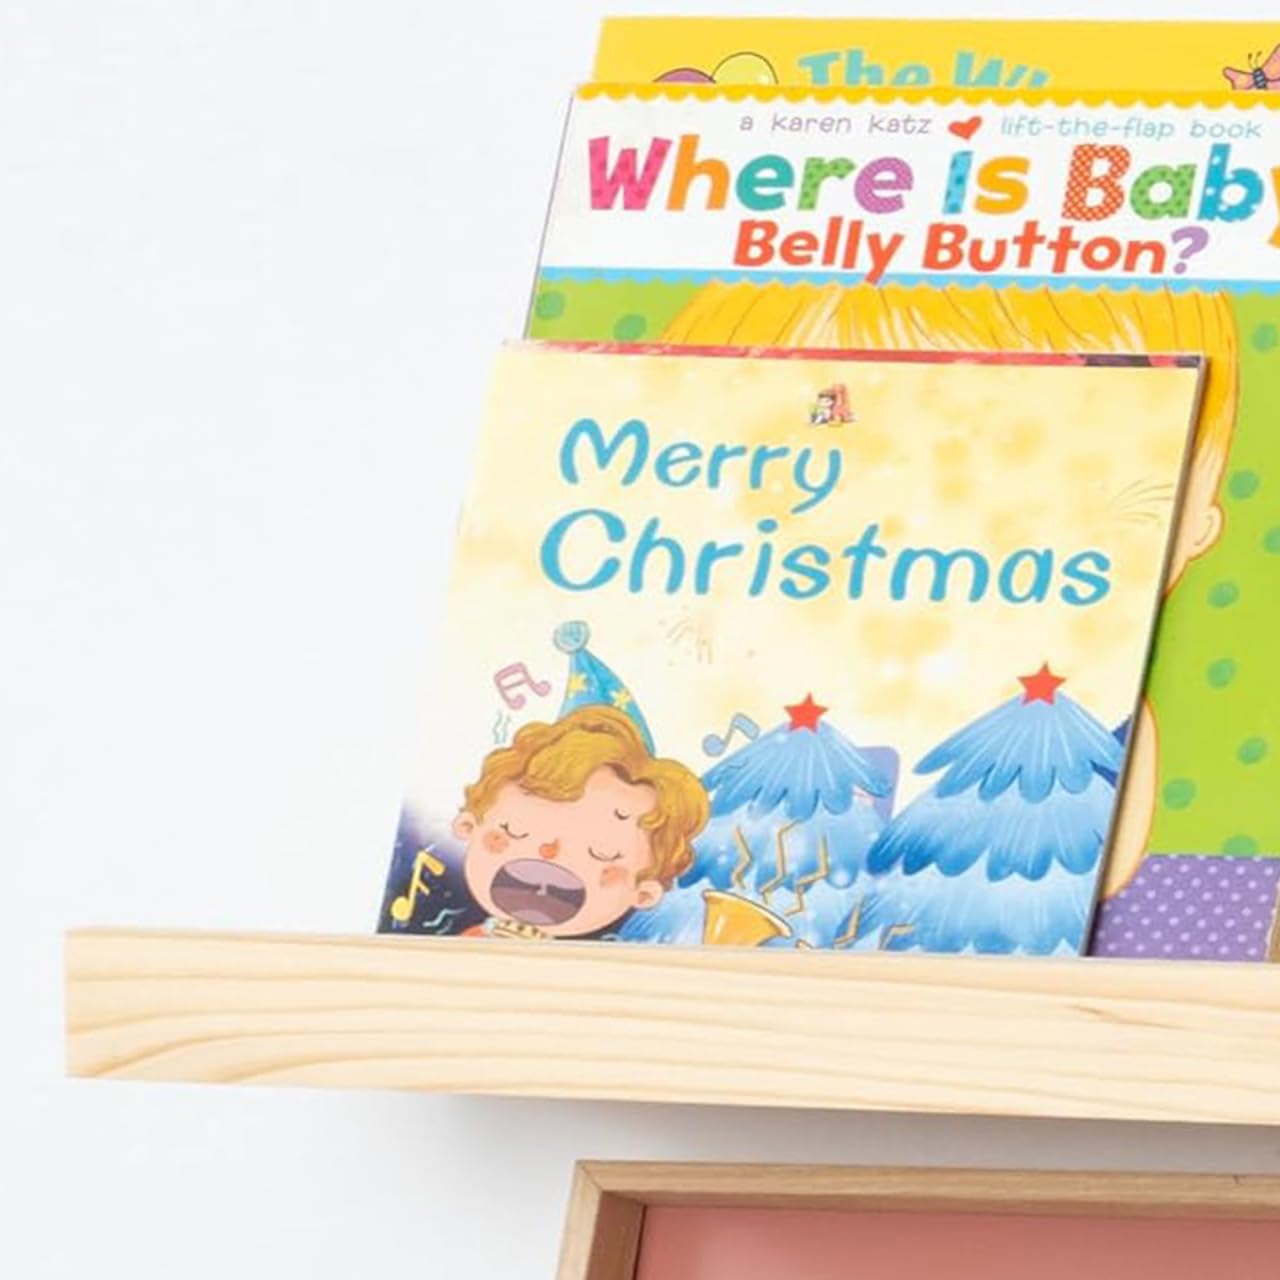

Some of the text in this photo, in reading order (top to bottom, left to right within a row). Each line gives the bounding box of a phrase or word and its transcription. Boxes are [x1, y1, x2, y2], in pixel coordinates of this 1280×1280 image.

[739, 114, 933, 134] a karen katz
[1001, 115, 1263, 140] lift-the-flap book
[588, 134, 914, 215] Where
[943, 150, 1031, 216] is
[733, 216, 1210, 285] Belly Button?
[559, 417, 843, 515] Merry
[540, 508, 1112, 607] Christmas
